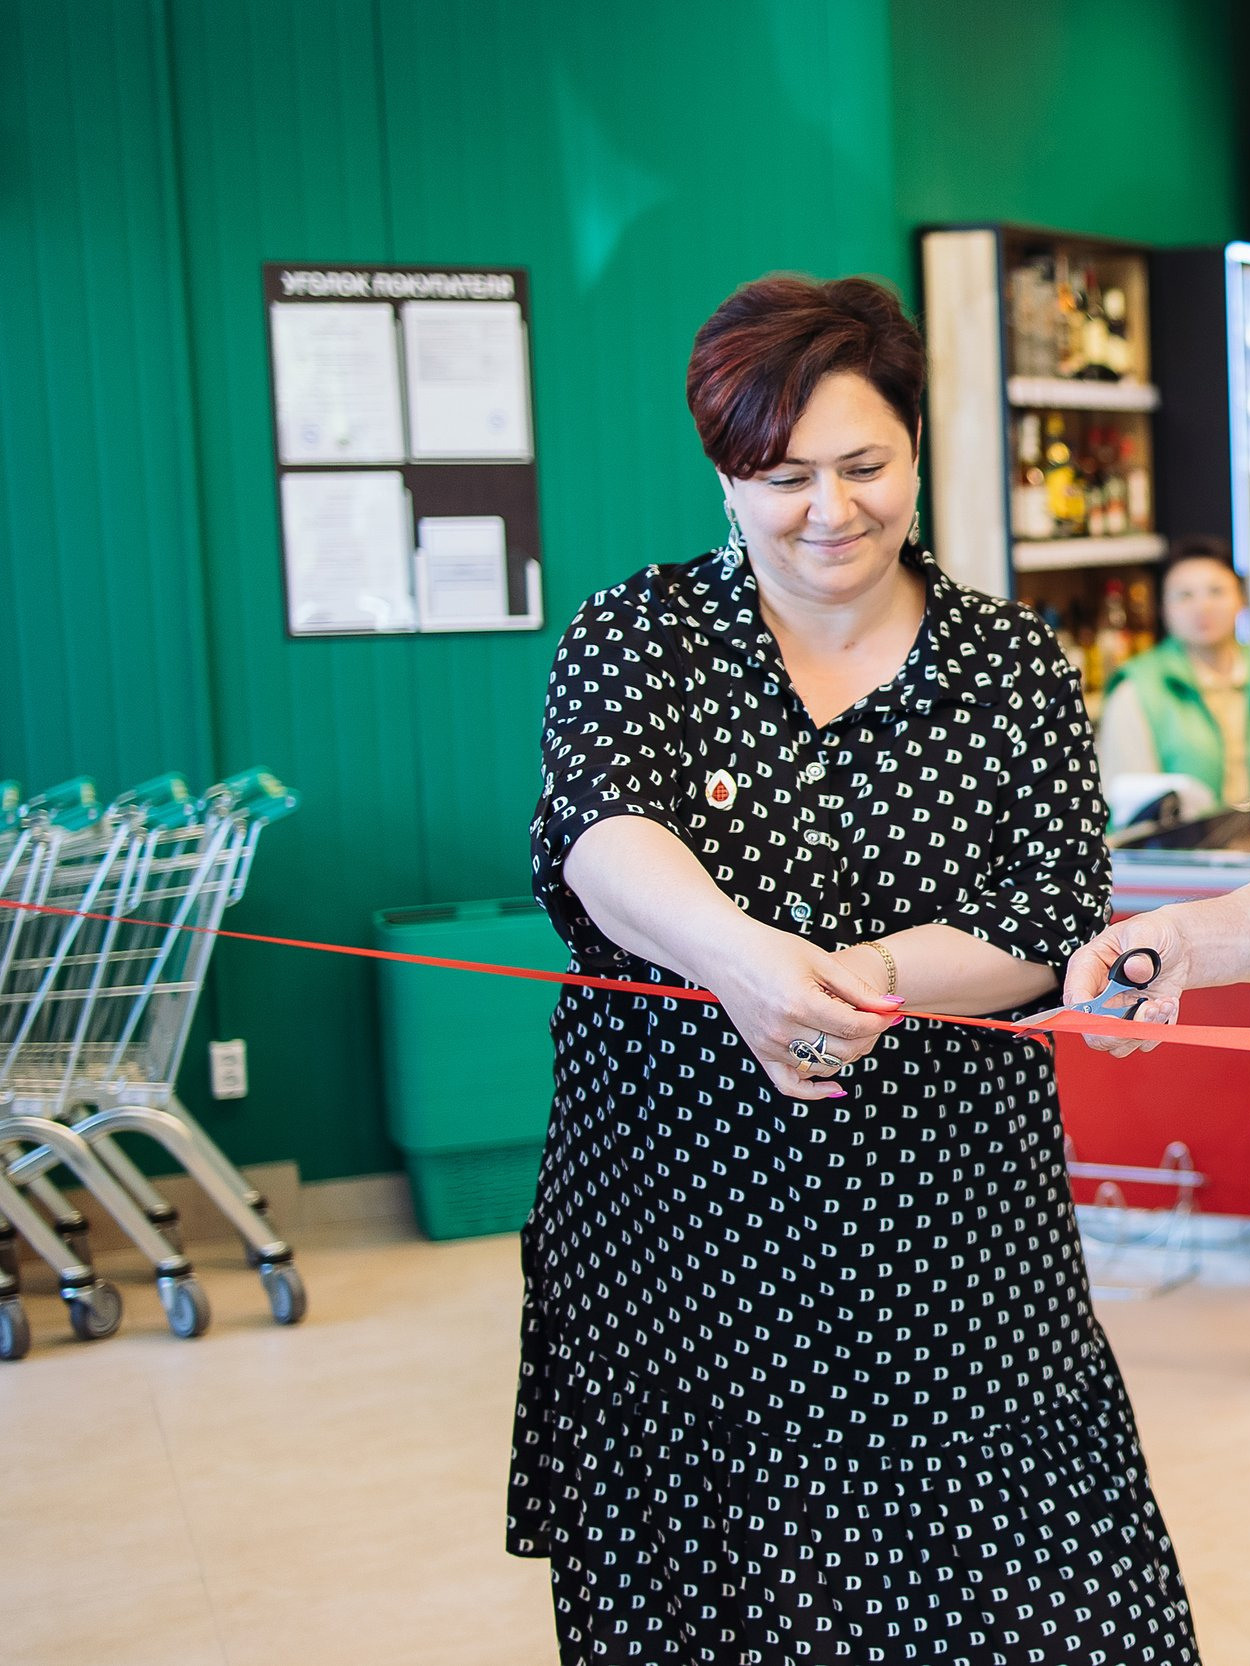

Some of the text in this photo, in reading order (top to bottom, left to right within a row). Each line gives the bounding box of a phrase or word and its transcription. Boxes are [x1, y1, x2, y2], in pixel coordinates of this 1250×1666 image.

[605, 628, 623, 641] D
[602, 663, 619, 676] D
[712, 657, 729, 672] D
[763, 682, 778, 695] D
[703, 698, 719, 714] D
[953, 709, 970, 724] D
[992, 715, 1008, 730] D
[623, 721, 643, 735] D
[714, 727, 731, 743] D
[760, 721, 777, 736] D
[929, 727, 947, 740] D
[859, 729, 873, 743] D
[968, 733, 986, 748] D
[905, 740, 922, 756] D
[945, 749, 962, 764] D
[984, 757, 1001, 772] D
[737, 773, 752, 788] D
[920, 767, 938, 781] D
[960, 774, 977, 790] D
[1054, 780, 1067, 793] D
[773, 789, 791, 804] D
[896, 782, 913, 798] D
[937, 790, 954, 805] D
[871, 801, 889, 815] D
[975, 800, 992, 815] D
[689, 814, 706, 828] D
[800, 807, 815, 823] D
[912, 808, 930, 822] D
[729, 819, 744, 833] D
[951, 816, 968, 832] D
[768, 830, 786, 846] D
[888, 825, 905, 840] D
[928, 832, 945, 847] D
[702, 838, 719, 853] D
[862, 845, 880, 859] D
[965, 843, 980, 859] D
[742, 845, 760, 861] D
[795, 846, 812, 861] D
[903, 851, 921, 866] D
[716, 865, 733, 881] D
[943, 859, 959, 875] D
[758, 875, 776, 892] D
[877, 871, 895, 886] D
[919, 877, 936, 893] D
[893, 898, 911, 913] D
[820, 913, 837, 929] D
[663, 996, 677, 1011] D
[703, 1004, 718, 1019] D
[681, 1022, 697, 1035] D
[722, 1032, 738, 1046] D
[700, 1048, 715, 1063] D
[680, 1065, 694, 1078] D
[904, 1061, 919, 1075] D
[698, 1091, 712, 1105] D
[678, 1107, 692, 1121] D
[792, 1103, 808, 1117] D
[834, 1109, 850, 1122] D
[757, 1129, 770, 1143] D
[810, 1129, 826, 1143] D
[881, 1127, 896, 1140] D
[733, 1146, 749, 1159] D
[828, 1154, 844, 1167] D
[692, 1175, 706, 1189] D
[805, 1175, 821, 1189] D
[770, 1197, 784, 1212] D
[824, 1200, 839, 1213] D
[863, 1198, 876, 1211] D
[899, 1194, 913, 1207] D
[747, 1214, 762, 1228] D
[880, 1218, 894, 1232] D
[725, 1229, 739, 1242] D
[843, 1222, 857, 1236] D
[861, 1243, 874, 1257] D
[915, 1259, 928, 1273] D
[951, 1255, 964, 1269] D
[879, 1263, 892, 1277] D
[722, 1270, 735, 1285] D
[759, 1281, 775, 1296] D
[738, 1298, 752, 1313] D
[838, 1307, 853, 1321] D
[755, 1326, 769, 1340] D
[735, 1340, 749, 1354] D
[794, 1335, 811, 1349] D
[617, 1342, 629, 1357] D
[915, 1348, 929, 1361] D
[751, 1367, 766, 1382] D
[895, 1371, 910, 1384] D
[586, 1379, 600, 1395] D
[831, 1386, 847, 1399] D
[953, 1386, 966, 1400] D
[1005, 1399, 1017, 1413] D
[933, 1411, 948, 1425] D
[785, 1421, 801, 1435] D
[826, 1429, 843, 1443] D
[868, 1434, 885, 1448] D
[769, 1448, 782, 1463] D
[981, 1446, 994, 1459] D
[1000, 1443, 1013, 1456] D
[583, 1454, 597, 1470] D
[927, 1457, 941, 1471] D
[756, 1469, 769, 1483] D
[809, 1481, 825, 1495] D
[947, 1479, 961, 1493] D
[885, 1502, 899, 1516] D
[969, 1498, 984, 1512] D
[749, 1516, 764, 1530] D
[784, 1522, 797, 1536] D
[929, 1522, 944, 1536] D
[992, 1515, 1008, 1530] D
[845, 1528, 860, 1542] D
[956, 1525, 972, 1539] D
[763, 1543, 778, 1558] D
[800, 1546, 813, 1559] D
[889, 1549, 903, 1563] D
[981, 1543, 997, 1558] D
[1034, 1548, 1050, 1563] D
[826, 1553, 841, 1567] D
[937, 1567, 953, 1581] D
[1006, 1560, 1021, 1575] D
[1059, 1566, 1074, 1579] D
[780, 1569, 796, 1583] D
[845, 1576, 861, 1590] D
[1027, 1576, 1041, 1591] D
[798, 1593, 812, 1607] D
[992, 1588, 1008, 1602] D
[866, 1600, 882, 1614] D
[896, 1596, 909, 1611] D
[748, 1605, 762, 1618] D
[1017, 1605, 1033, 1620] D
[1075, 1607, 1091, 1622] D
[1129, 1604, 1141, 1619] D
[816, 1617, 832, 1631] D
[914, 1618, 927, 1632] D
[946, 1612, 962, 1626] D
[849, 1623, 862, 1637] D
[888, 1623, 900, 1637] D
[1041, 1620, 1057, 1636] D
[970, 1632, 985, 1645] D
[1065, 1635, 1081, 1651] D
[629, 1641, 641, 1655] D
[796, 1641, 811, 1655] D
[836, 1641, 850, 1655] D
[869, 1648, 884, 1661] D
[1142, 1646, 1154, 1661] D
[1028, 1649, 1044, 1663] D
